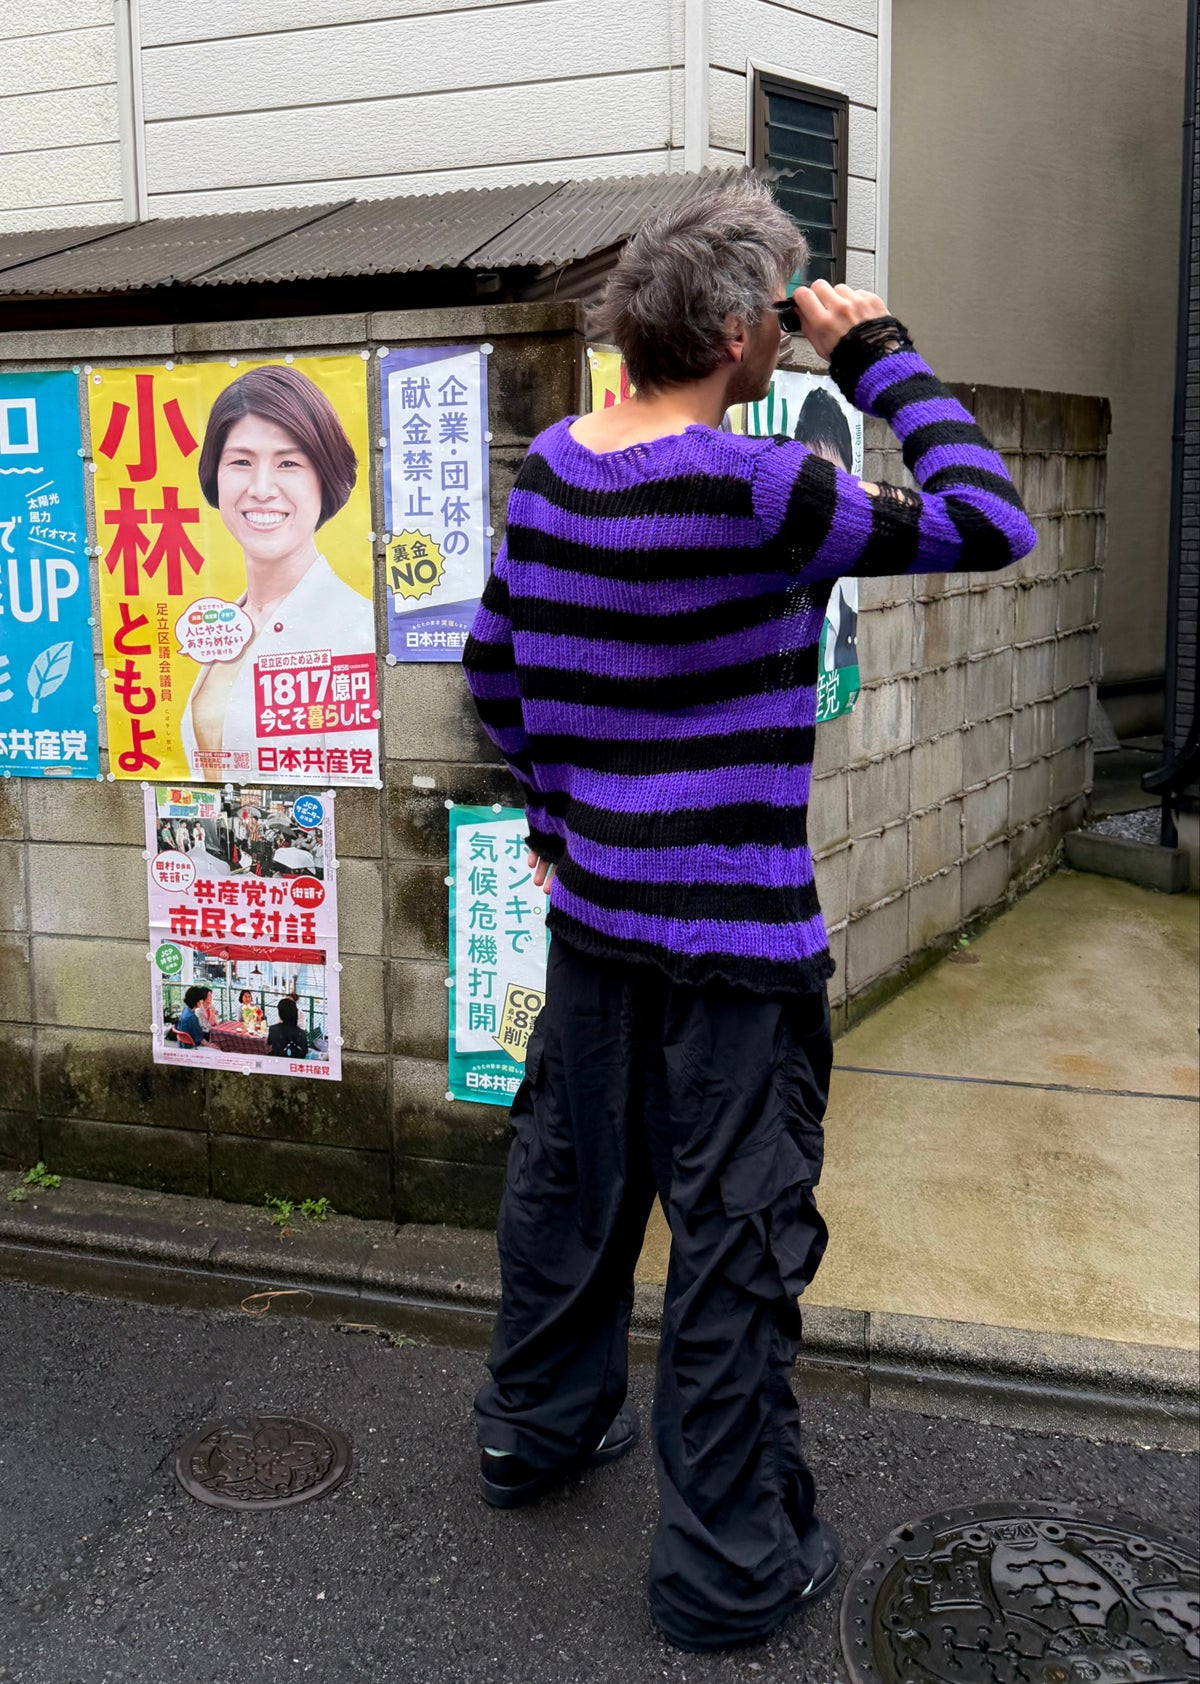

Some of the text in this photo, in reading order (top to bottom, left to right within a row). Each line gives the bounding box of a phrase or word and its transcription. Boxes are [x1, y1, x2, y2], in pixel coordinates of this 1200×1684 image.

[400, 376, 434, 517] 献金禁止
[437, 374, 471, 556] 企業・団体の
[27, 493, 60, 510] 太陽光
[29, 511, 51, 523] 風力
[29, 525, 77, 543] バイオマス
[391, 540, 428, 563] 裏金
[99, 374, 205, 773] 小林ともよ
[391, 559, 437, 590] NO
[0, 558, 80, 623] UP
[185, 623, 243, 638] 人にやさしく
[187, 635, 244, 649] あきらめない
[156, 602, 173, 703] 足立区議会議員
[260, 653, 329, 669] 足立区のため込み金
[259, 669, 370, 707] 1817億円
[260, 702, 371, 733] 今こそ暮らしに
[257, 746, 373, 774] 日本共産党
[303, 801, 318, 811] JCP
[159, 872, 189, 883] 先頭に
[193, 879, 288, 907] 共産党が
[292, 886, 324, 900] 街頭で
[504, 833, 533, 954] ホンキで
[168, 905, 316, 945] 市民と対話
[467, 831, 498, 1033] 気候危機打開
[503, 1026, 529, 1048] 削
[289, 1062, 331, 1076] 日本共産党
